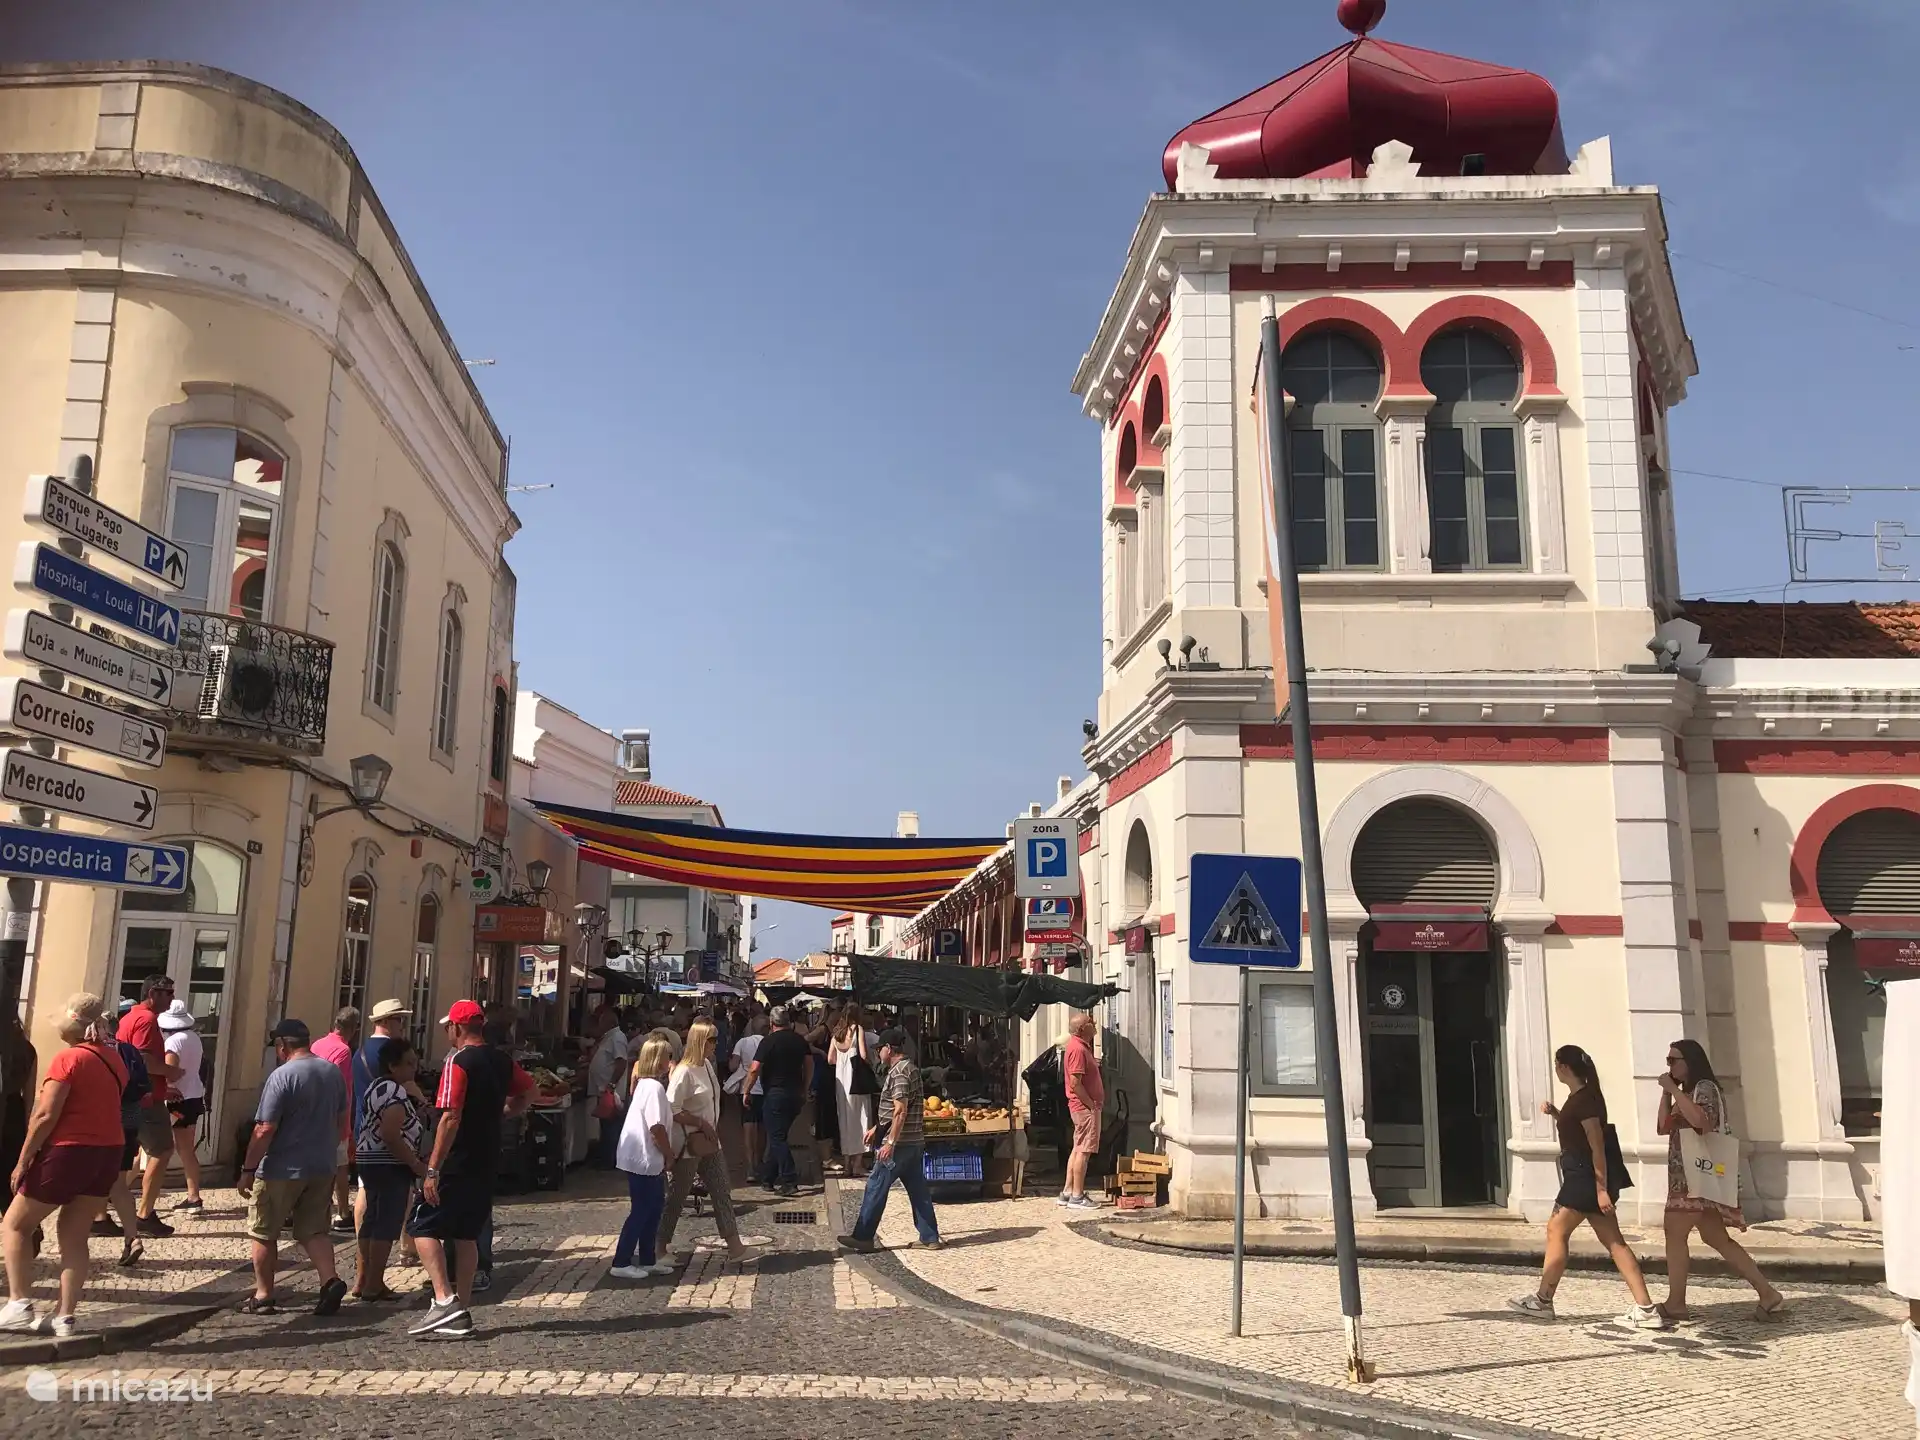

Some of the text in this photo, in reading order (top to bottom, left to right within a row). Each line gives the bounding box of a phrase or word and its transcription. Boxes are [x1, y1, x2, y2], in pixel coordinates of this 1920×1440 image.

[47, 503, 119, 551] 281 Lugares
[49, 484, 122, 534] Parque Pago
[149, 543, 160, 565] P
[38, 560, 87, 595] Hospital
[105, 590, 133, 615] Loulé
[139, 600, 154, 632] H
[29, 628, 124, 677] Loja do Munícipe
[18, 693, 95, 736] Correios
[7, 763, 85, 802] Mercado
[1032, 825, 1059, 833] zona
[0, 836, 112, 872] ospedaria
[1036, 842, 1058, 874] P
[940, 931, 956, 953] P
